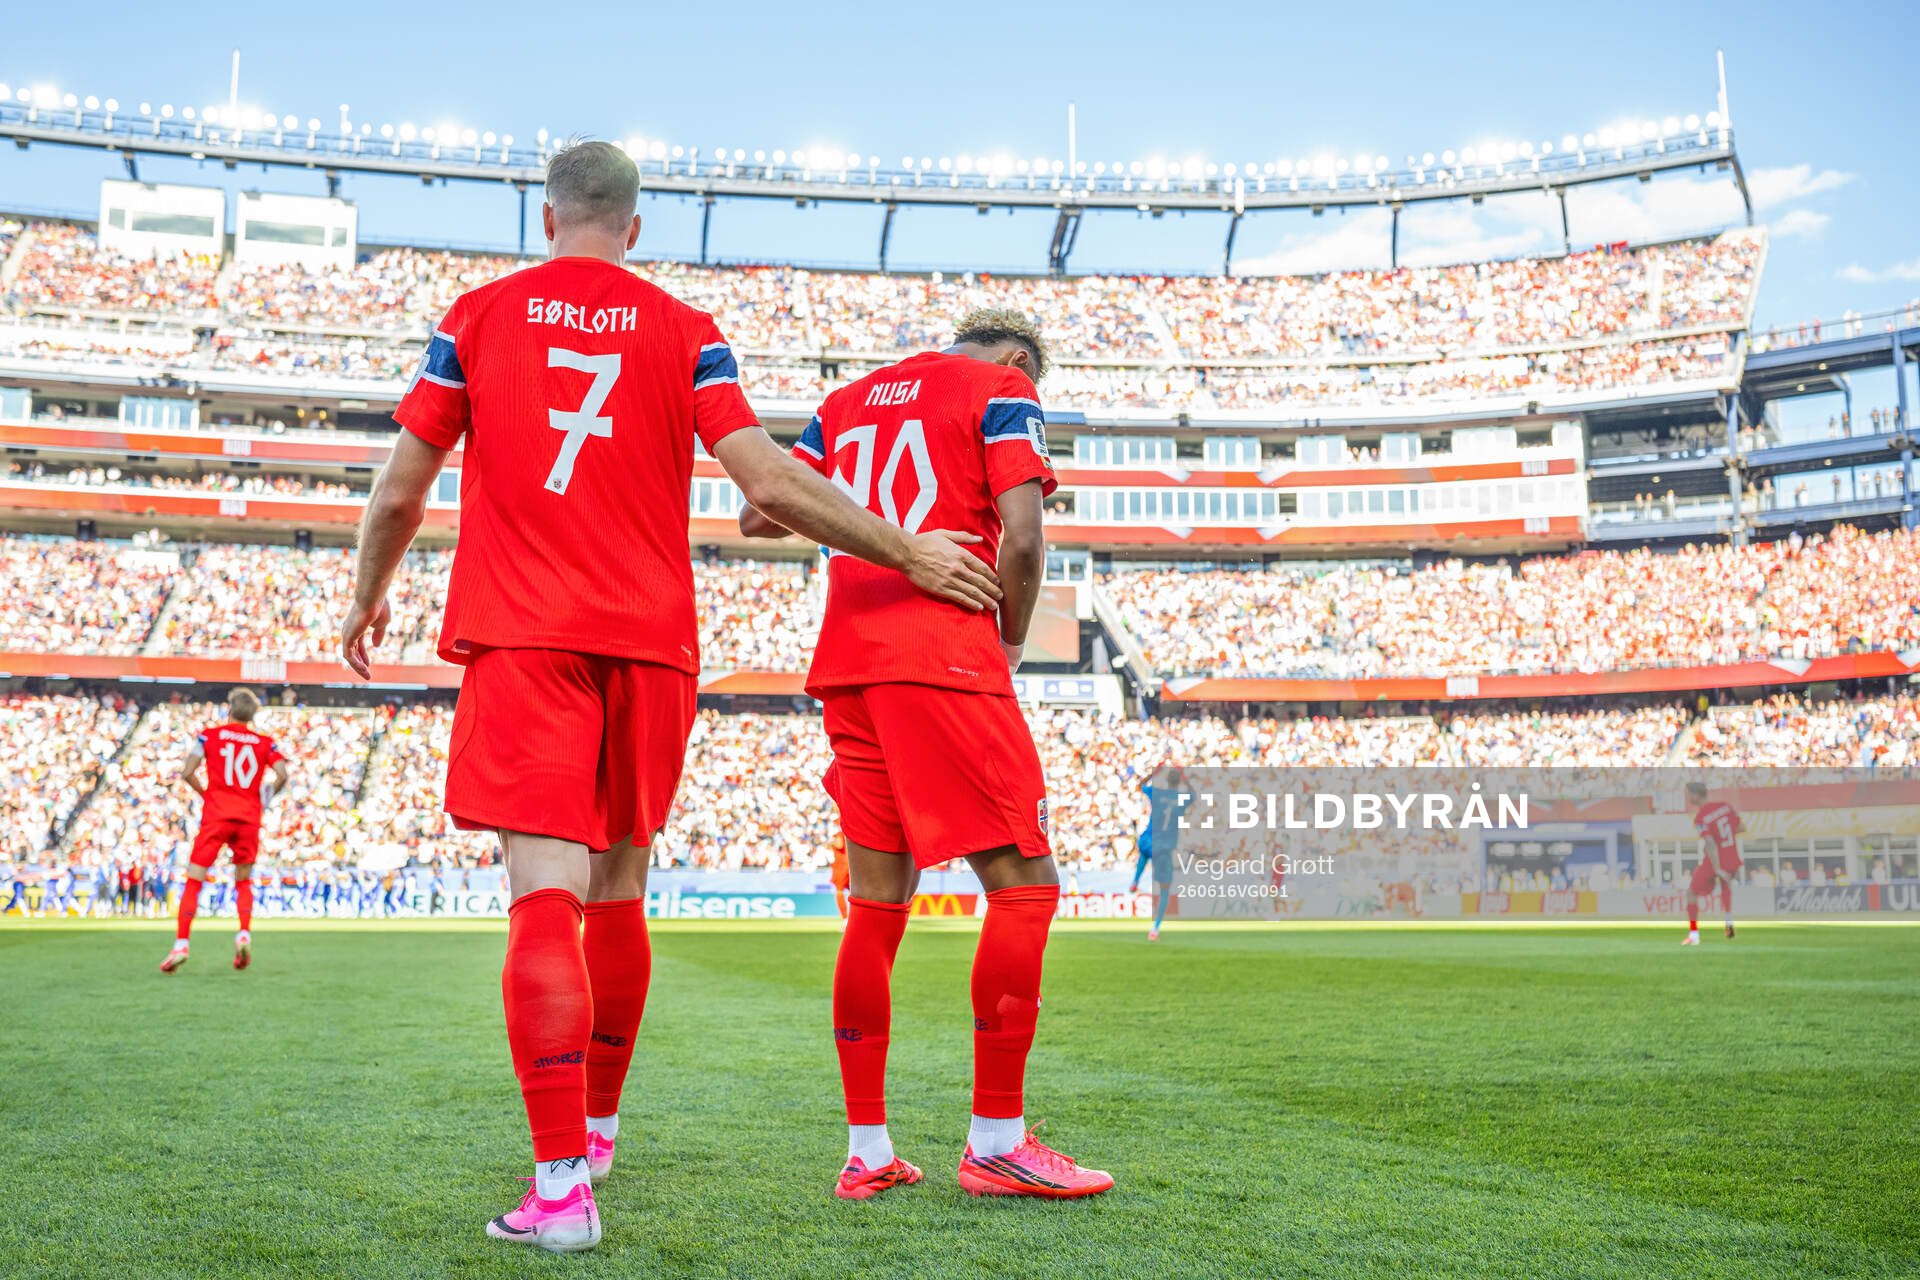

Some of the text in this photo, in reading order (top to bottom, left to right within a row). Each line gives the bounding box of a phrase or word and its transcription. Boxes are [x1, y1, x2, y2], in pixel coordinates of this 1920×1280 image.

[527, 298, 637, 334] SØRLOTH
[864, 379, 922, 406] NUSA
[544, 347, 622, 496] 7
[829, 419, 938, 548] 20
[219, 742, 259, 789] 10
[1717, 816, 1734, 849] 5
[412, 895, 502, 913] ERICA
[645, 889, 796, 919] Hisense
[1643, 889, 1724, 913] verion
